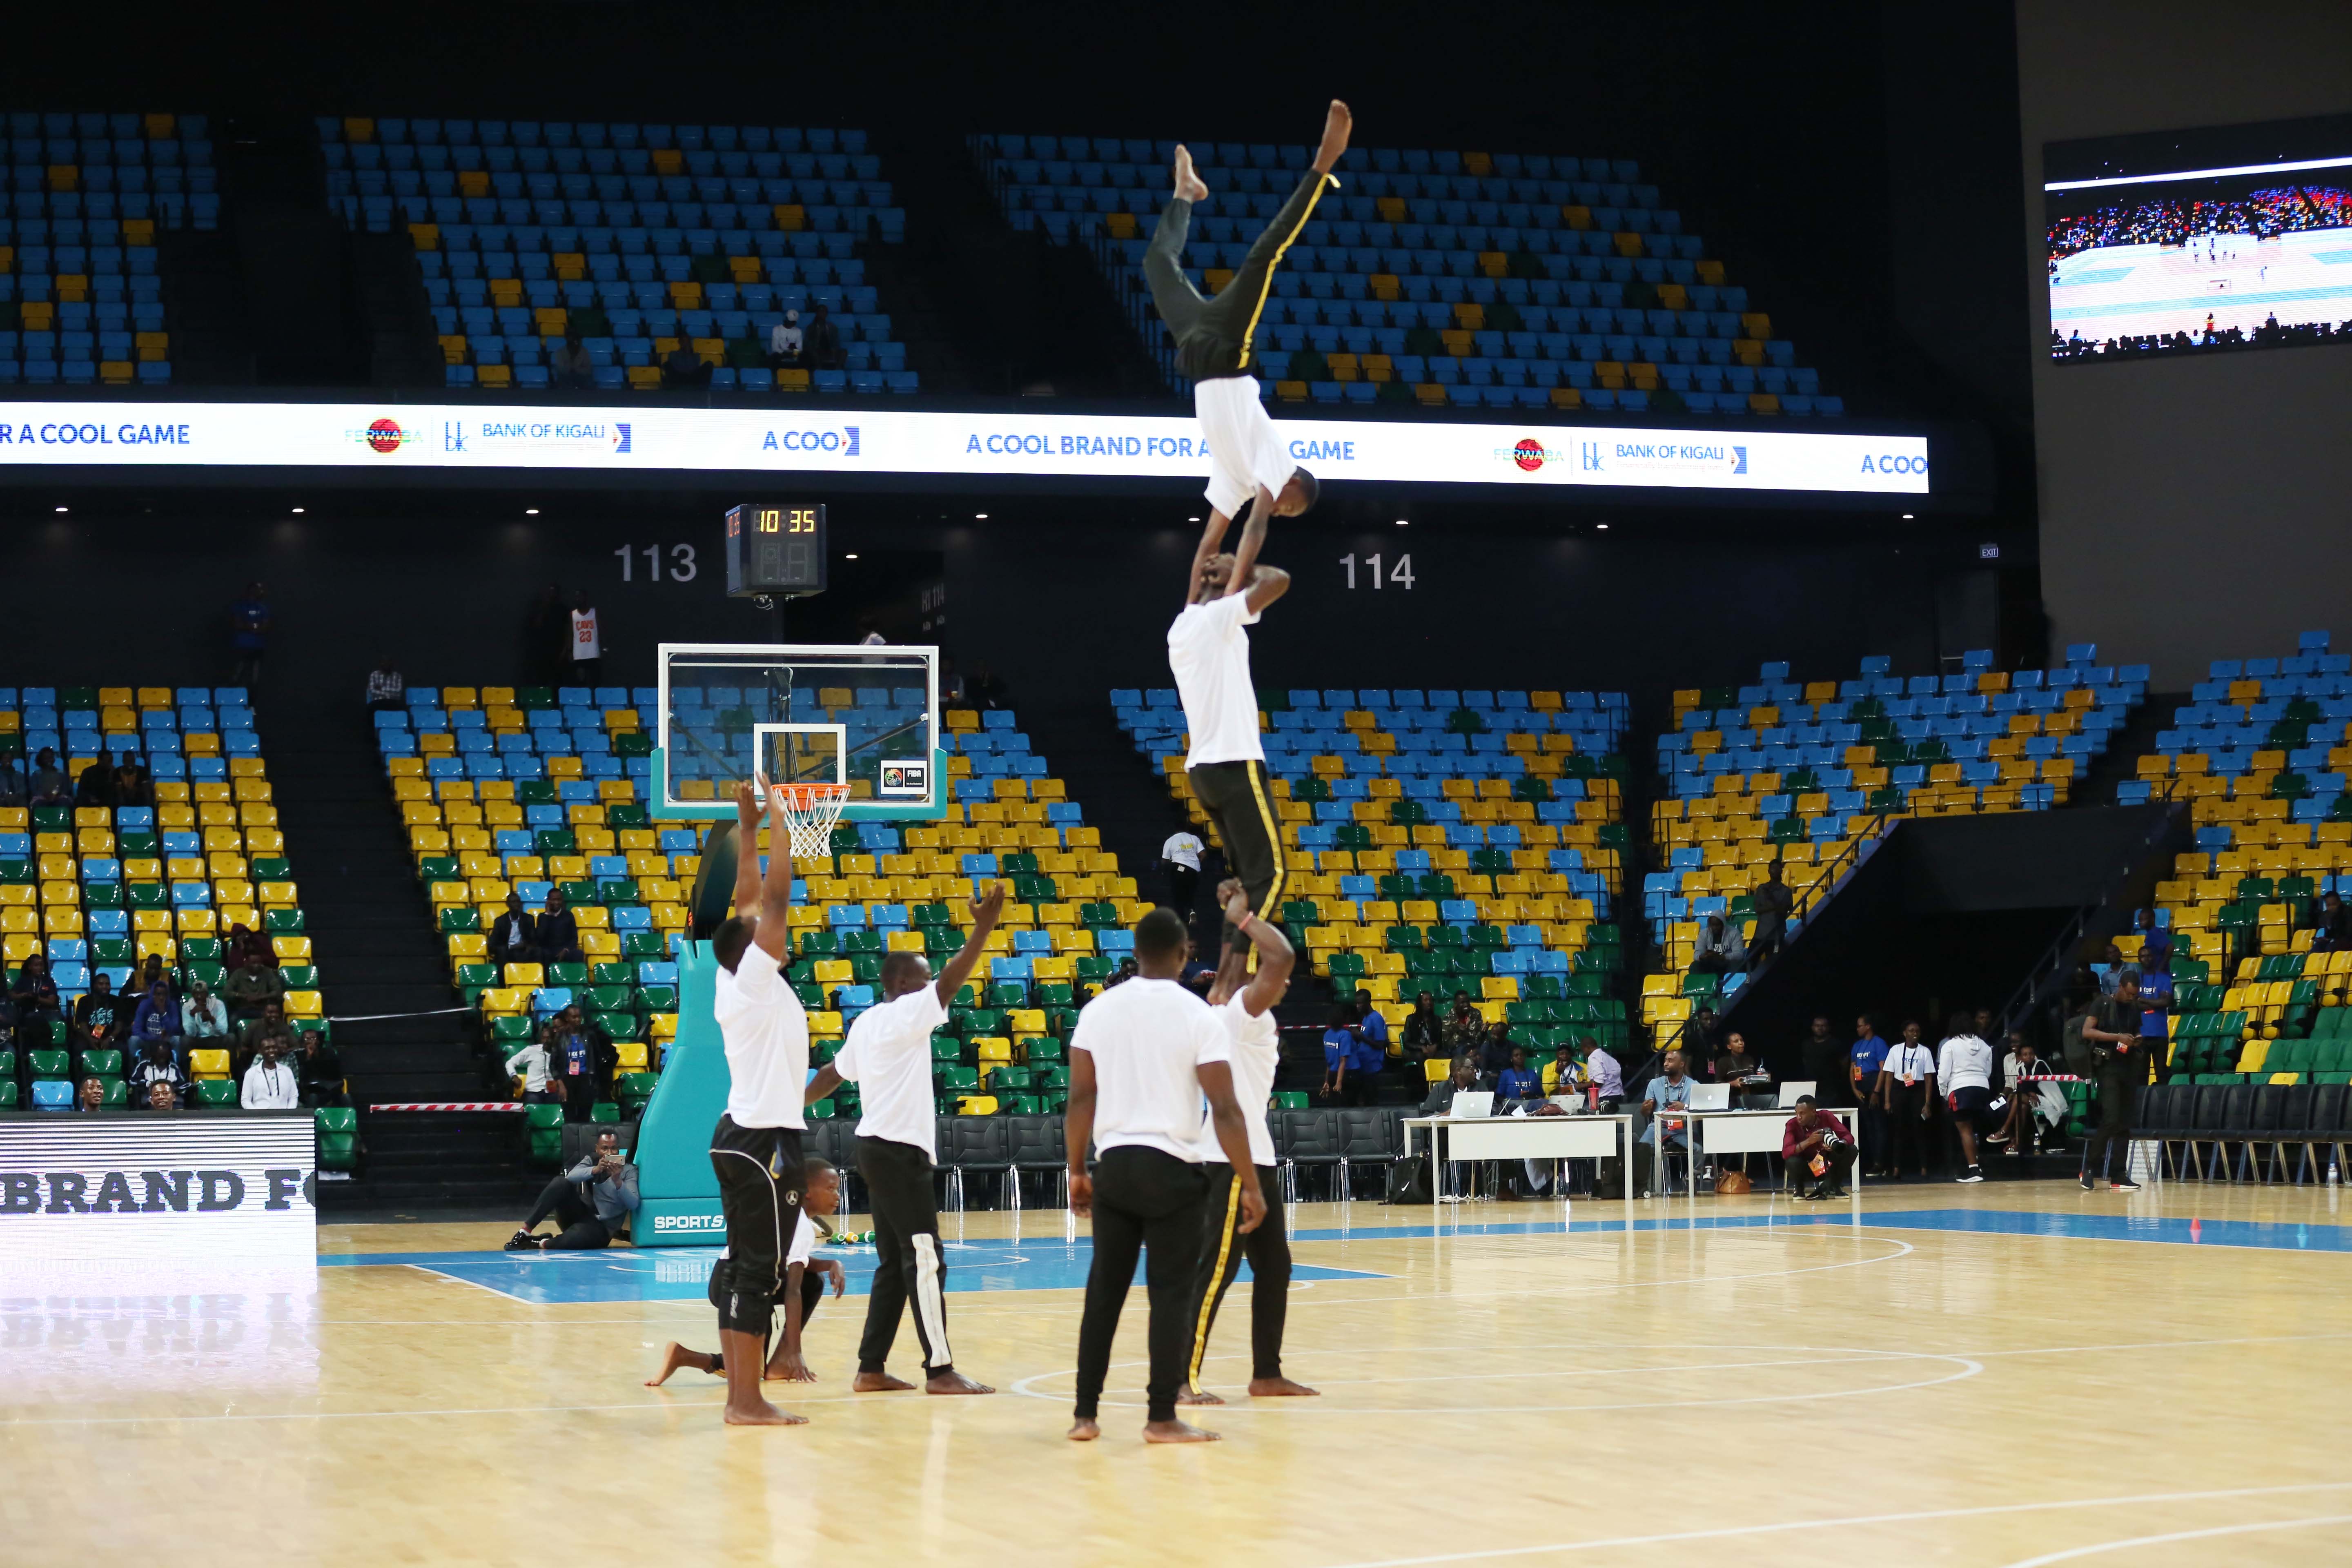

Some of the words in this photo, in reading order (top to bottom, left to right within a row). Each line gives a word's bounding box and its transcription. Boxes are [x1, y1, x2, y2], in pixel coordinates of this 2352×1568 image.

[19, 424, 35, 443] A
[40, 424, 113, 444] COOL
[118, 424, 190, 444] GAME
[483, 423, 526, 437] BANK
[530, 423, 551, 438] OF
[556, 424, 605, 438] KIGALI
[762, 431, 778, 450] A
[967, 434, 982, 454] A
[987, 434, 1055, 454] COOL
[1060, 436, 1142, 457] BRAND
[1147, 437, 1193, 457] FOR
[1289, 440, 1355, 460] GAME
[1617, 444, 1655, 458] BANK
[1659, 445, 1677, 458] OF
[1681, 446, 1724, 460] KIGALI
[1861, 454, 1875, 473] A
[760, 510, 779, 532] 10
[789, 510, 815, 532] 35
[615, 543, 697, 582] 113
[1339, 553, 1415, 589] 114
[579, 630, 592, 642] 23
[0, 1170, 244, 1213] BRAND
[655, 1215, 724, 1229] SPORTS
